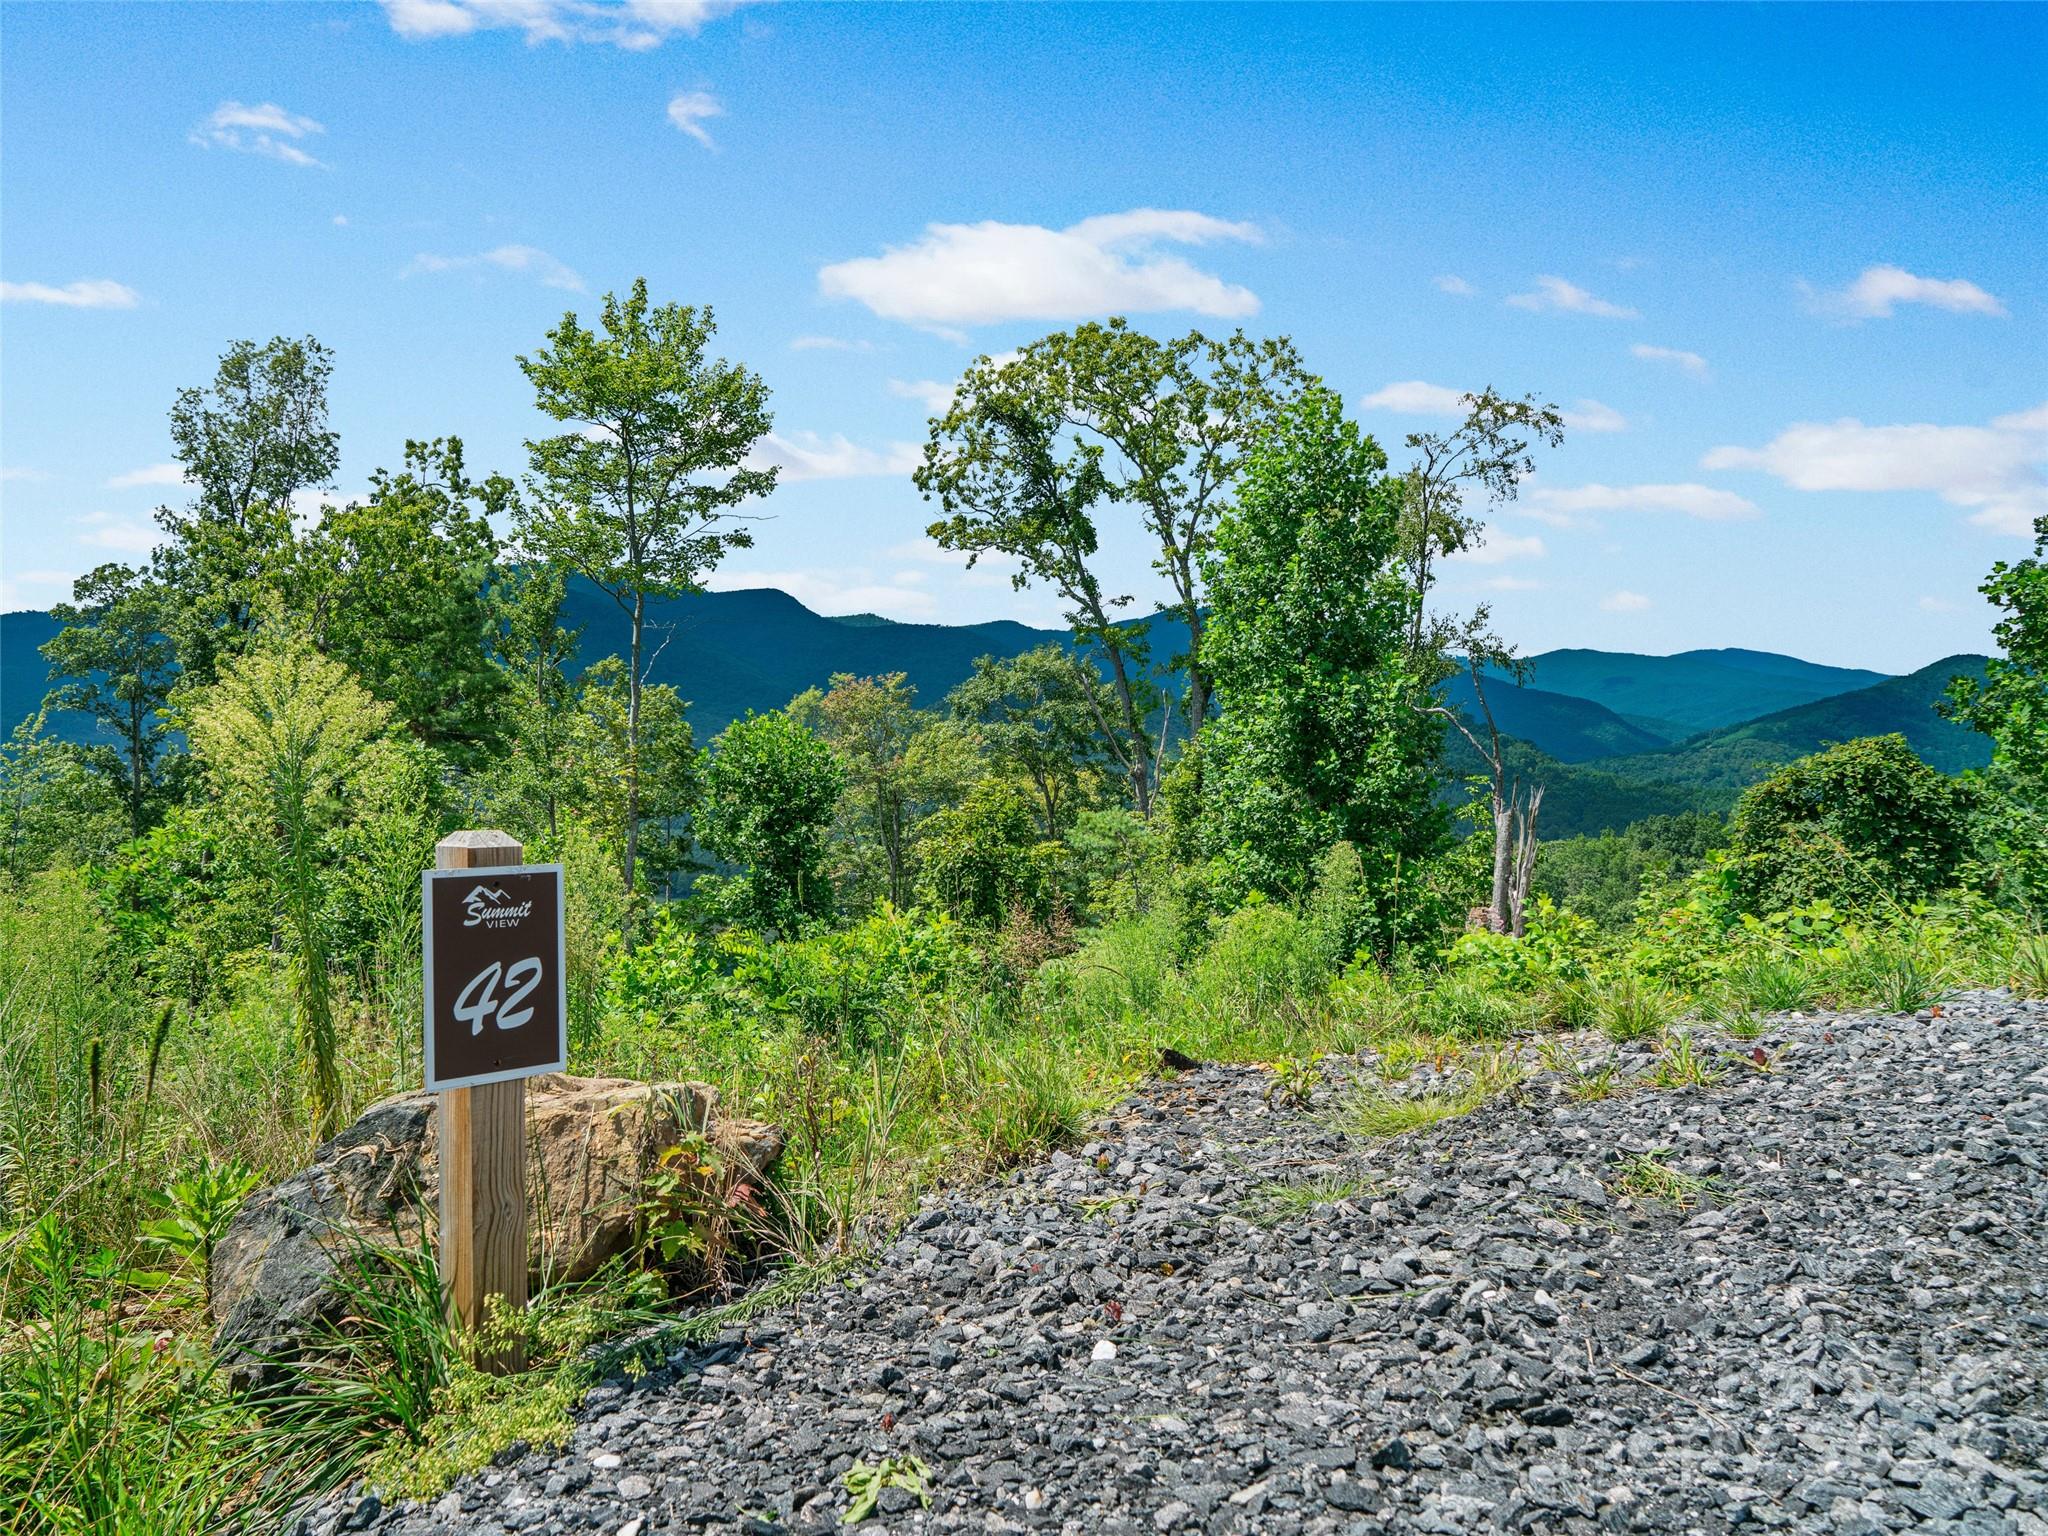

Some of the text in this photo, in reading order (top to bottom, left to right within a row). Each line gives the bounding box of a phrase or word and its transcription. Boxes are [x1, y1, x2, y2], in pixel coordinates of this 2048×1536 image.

[463, 900, 532, 927] Summit
[486, 918, 520, 929] VIEW
[453, 957, 543, 1036] 42
